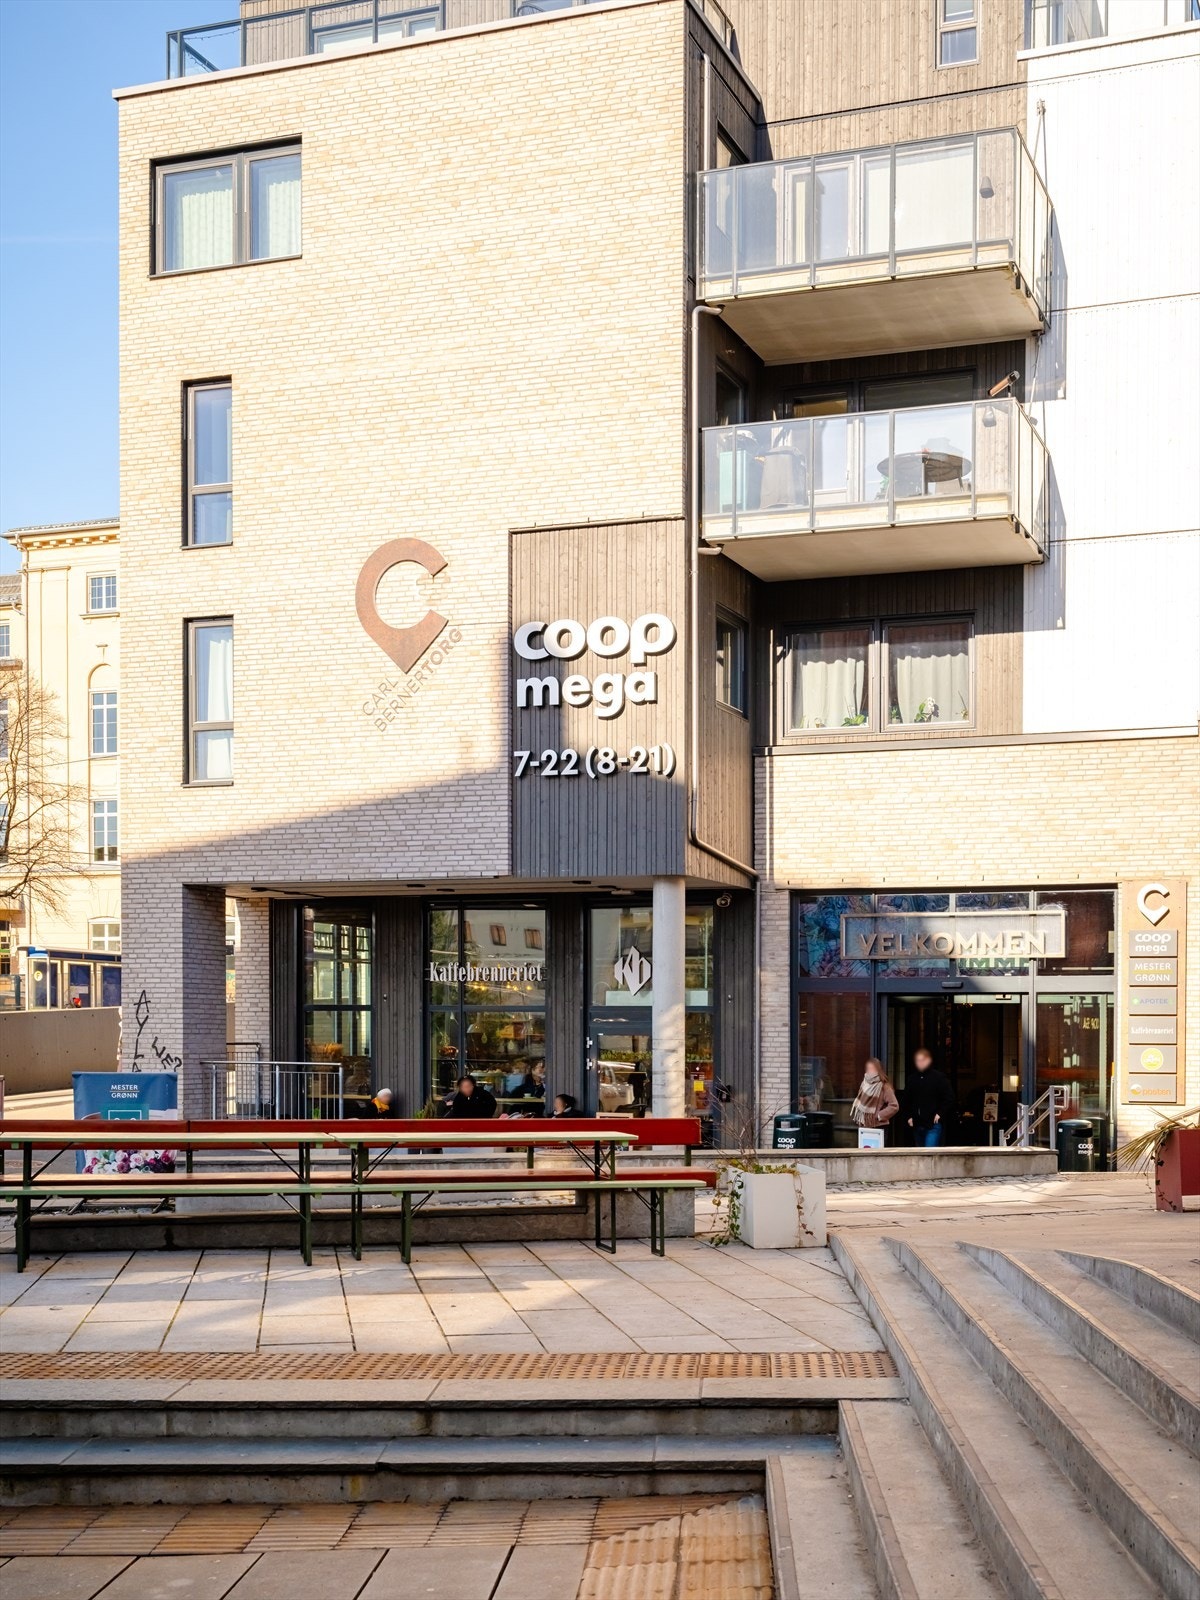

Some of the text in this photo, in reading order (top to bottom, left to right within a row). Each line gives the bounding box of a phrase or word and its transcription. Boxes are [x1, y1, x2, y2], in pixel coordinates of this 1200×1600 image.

[513, 613, 677, 665] coop
[373, 628, 463, 732] BERNERTORG
[362, 677, 398, 716] CARL
[516, 671, 657, 719] mega
[513, 742, 676, 778] 7-22 (8-21)
[860, 930, 1046, 956] VELKOMMEN
[1135, 933, 1172, 944] coop
[1135, 945, 1167, 955] mega
[430, 961, 543, 982] Kaffebrenneriet
[1135, 962, 1171, 970] MESTER
[1135, 974, 1170, 982] GRØNN
